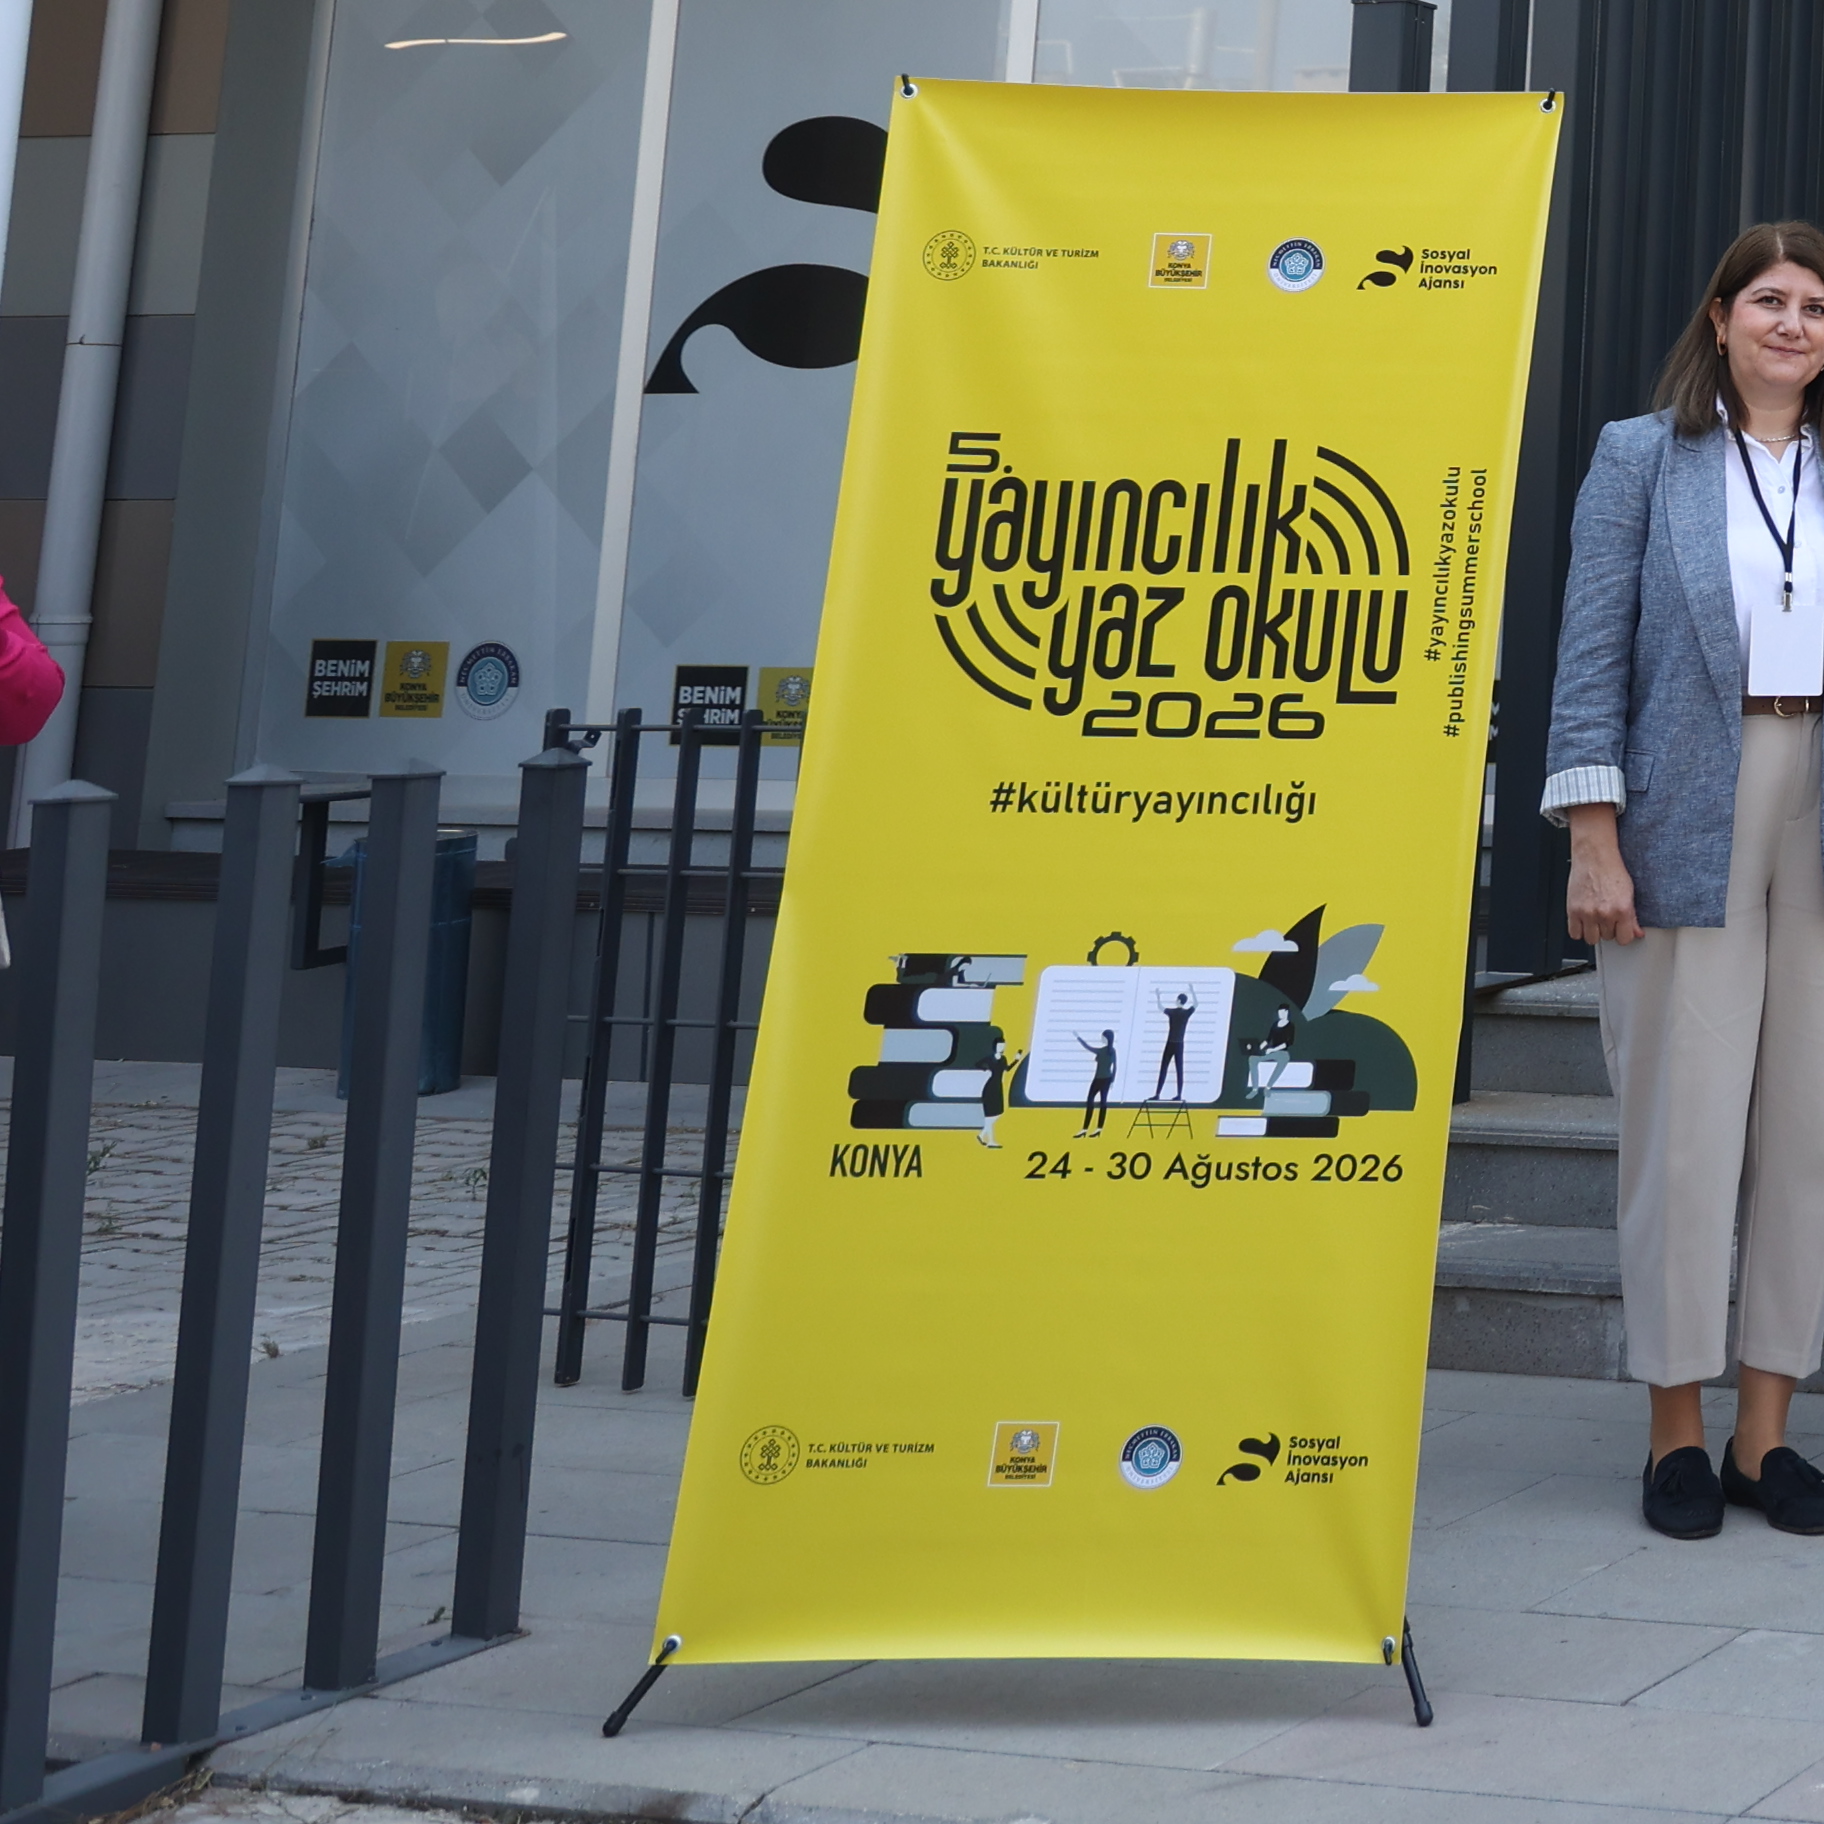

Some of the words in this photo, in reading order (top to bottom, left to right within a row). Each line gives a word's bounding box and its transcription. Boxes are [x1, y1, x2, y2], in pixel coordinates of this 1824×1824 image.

[983, 247, 1000, 257] T.C.
[1003, 246, 1043, 257] KÜLTÜR
[1046, 249, 1058, 257] VE
[1061, 247, 1099, 258] TURİZM
[1421, 248, 1470, 262] Sosyal
[982, 258, 1039, 270] BAKANLIĞI
[1420, 261, 1498, 277] İnovasyon
[1418, 277, 1465, 290] Ajansı
[930, 438, 1307, 608] yayıncılık
[1423, 466, 1461, 662] #yayıncılıkyazokulu
[1443, 468, 1487, 738] #publishingsummerschool
[1043, 583, 1185, 716] yaz
[1081, 691, 1325, 740] 2026
[989, 780, 1317, 824] #kültüryayıncılığı
[829, 1144, 923, 1178] KONYA
[1024, 1152, 1072, 1179] 24
[1106, 1153, 1152, 1180] 30
[1163, 1153, 1299, 1189] Ağustos
[1311, 1154, 1404, 1182] 2026
[808, 1444, 826, 1454] T.C.
[829, 1442, 873, 1454] KÜLTÜR
[876, 1444, 889, 1454] VE
[892, 1442, 935, 1454] TURİZM
[1289, 1436, 1340, 1450] Sosyal
[806, 1456, 867, 1469] BAKANLIĞI
[1287, 1450, 1369, 1470] İnovasyon
[1284, 1469, 1334, 1486] Ajansı
